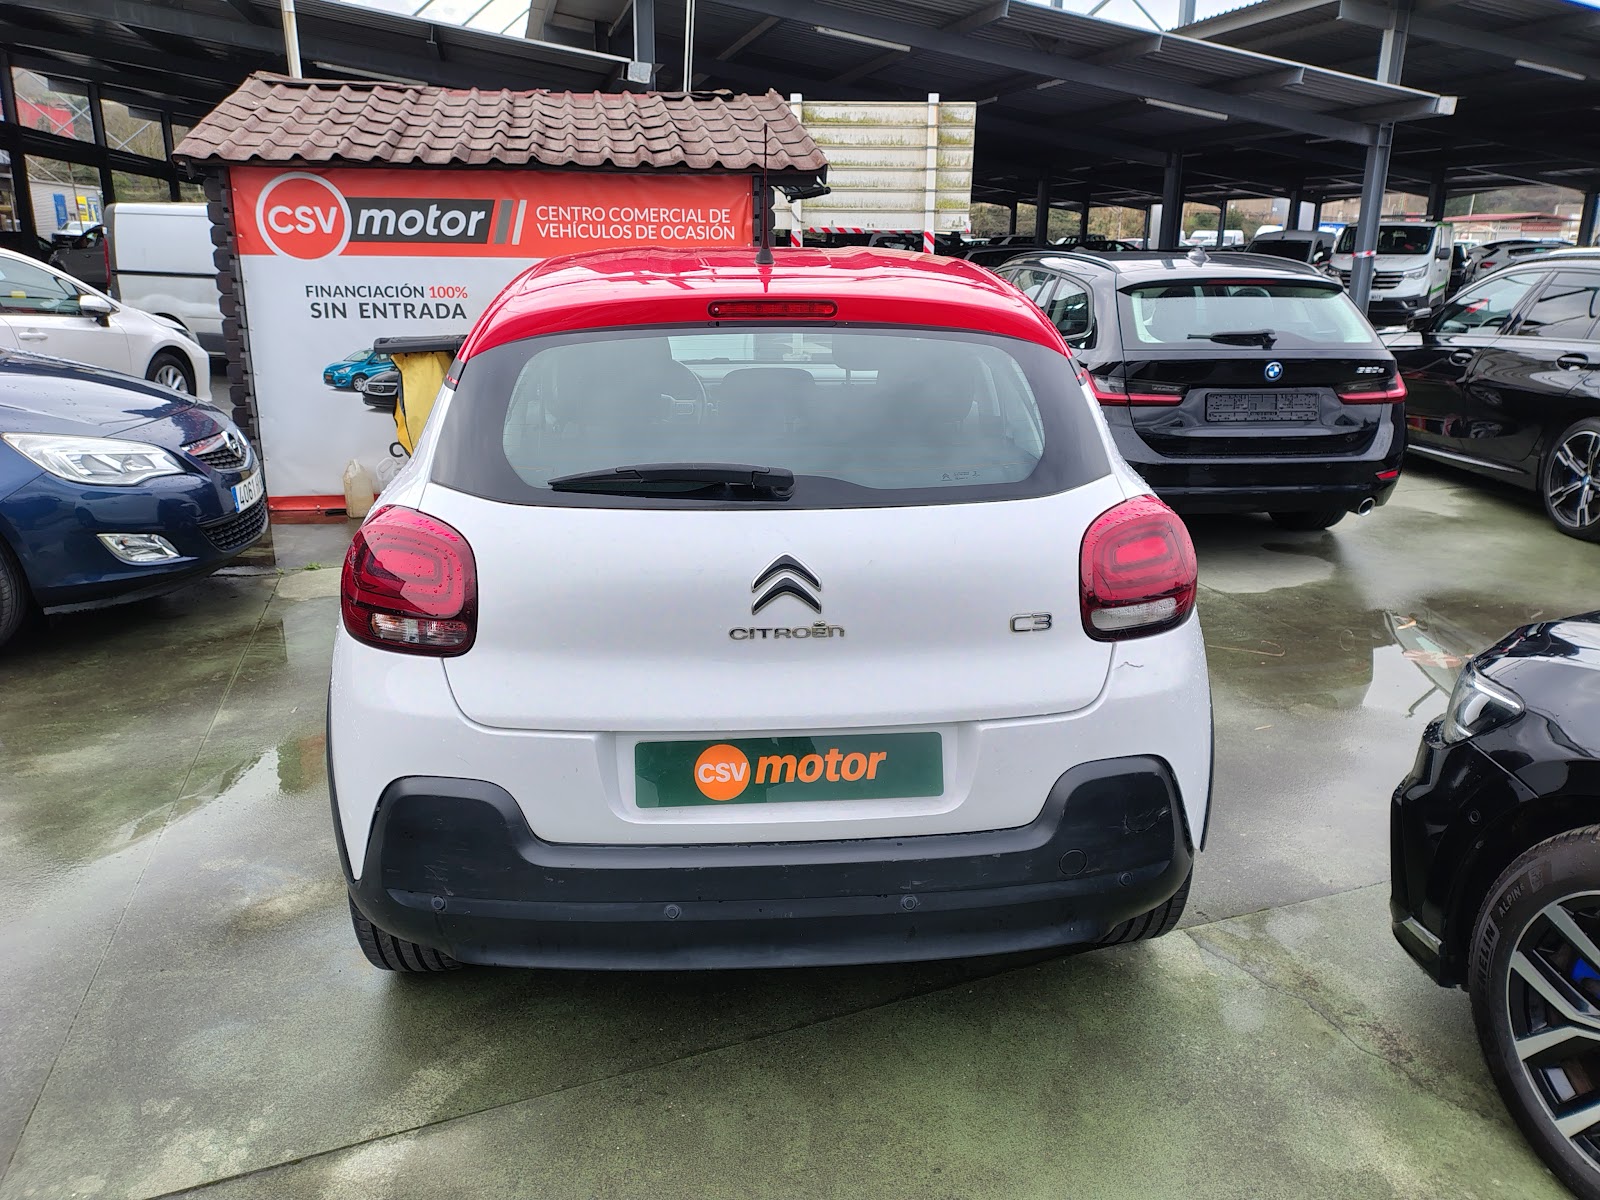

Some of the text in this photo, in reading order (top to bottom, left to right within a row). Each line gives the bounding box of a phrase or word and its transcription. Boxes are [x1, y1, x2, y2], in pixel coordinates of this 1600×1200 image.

[267, 203, 486, 237] CSV motor
[535, 205, 731, 223] CENTRO COMERCIAL DE
[536, 220, 735, 240] VEHÍCULOS DE OCASIÓN
[305, 283, 468, 299] FINANCIACIÓN 100%
[310, 302, 467, 319] SIN ENTRADA
[1009, 611, 1052, 634] C3
[697, 748, 887, 784] CSV motor
